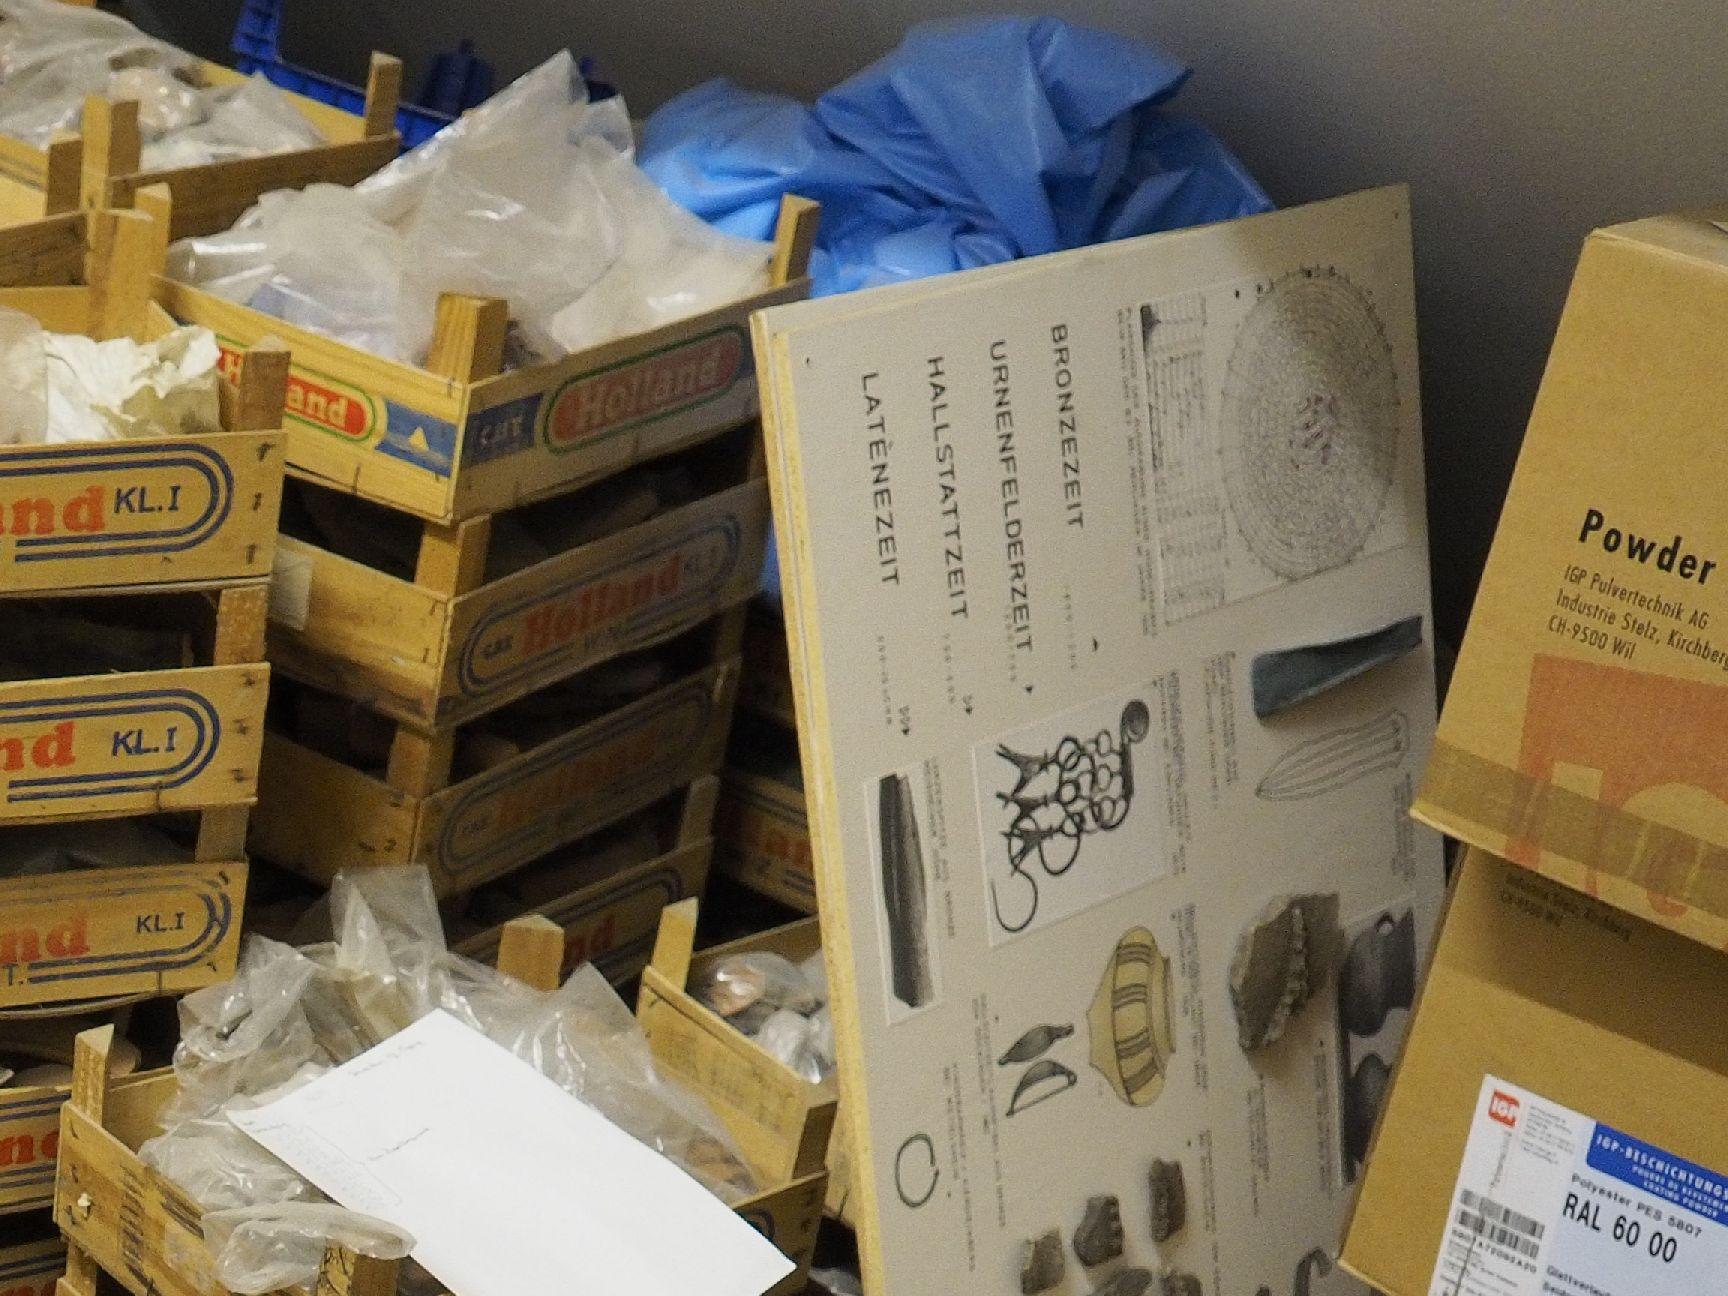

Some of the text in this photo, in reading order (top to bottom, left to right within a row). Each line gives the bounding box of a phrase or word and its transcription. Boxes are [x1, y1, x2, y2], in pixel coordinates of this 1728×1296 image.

[572, 337, 722, 433] Holland
[1050, 322, 1084, 530] BRONZEZEIT
[927, 355, 968, 619] HALLSTATTZEIT
[989, 338, 1033, 655] URNENFELDERZEIT
[1578, 507, 1718, 585] Powder
[1548, 614, 1637, 661] CH-9500 Wil
[1556, 588, 1617, 627] Industrie
[1590, 571, 1686, 623] Pulvertechnik
[1688, 606, 1710, 630] AG
[1563, 1193, 1678, 1264] RAL 60 00
